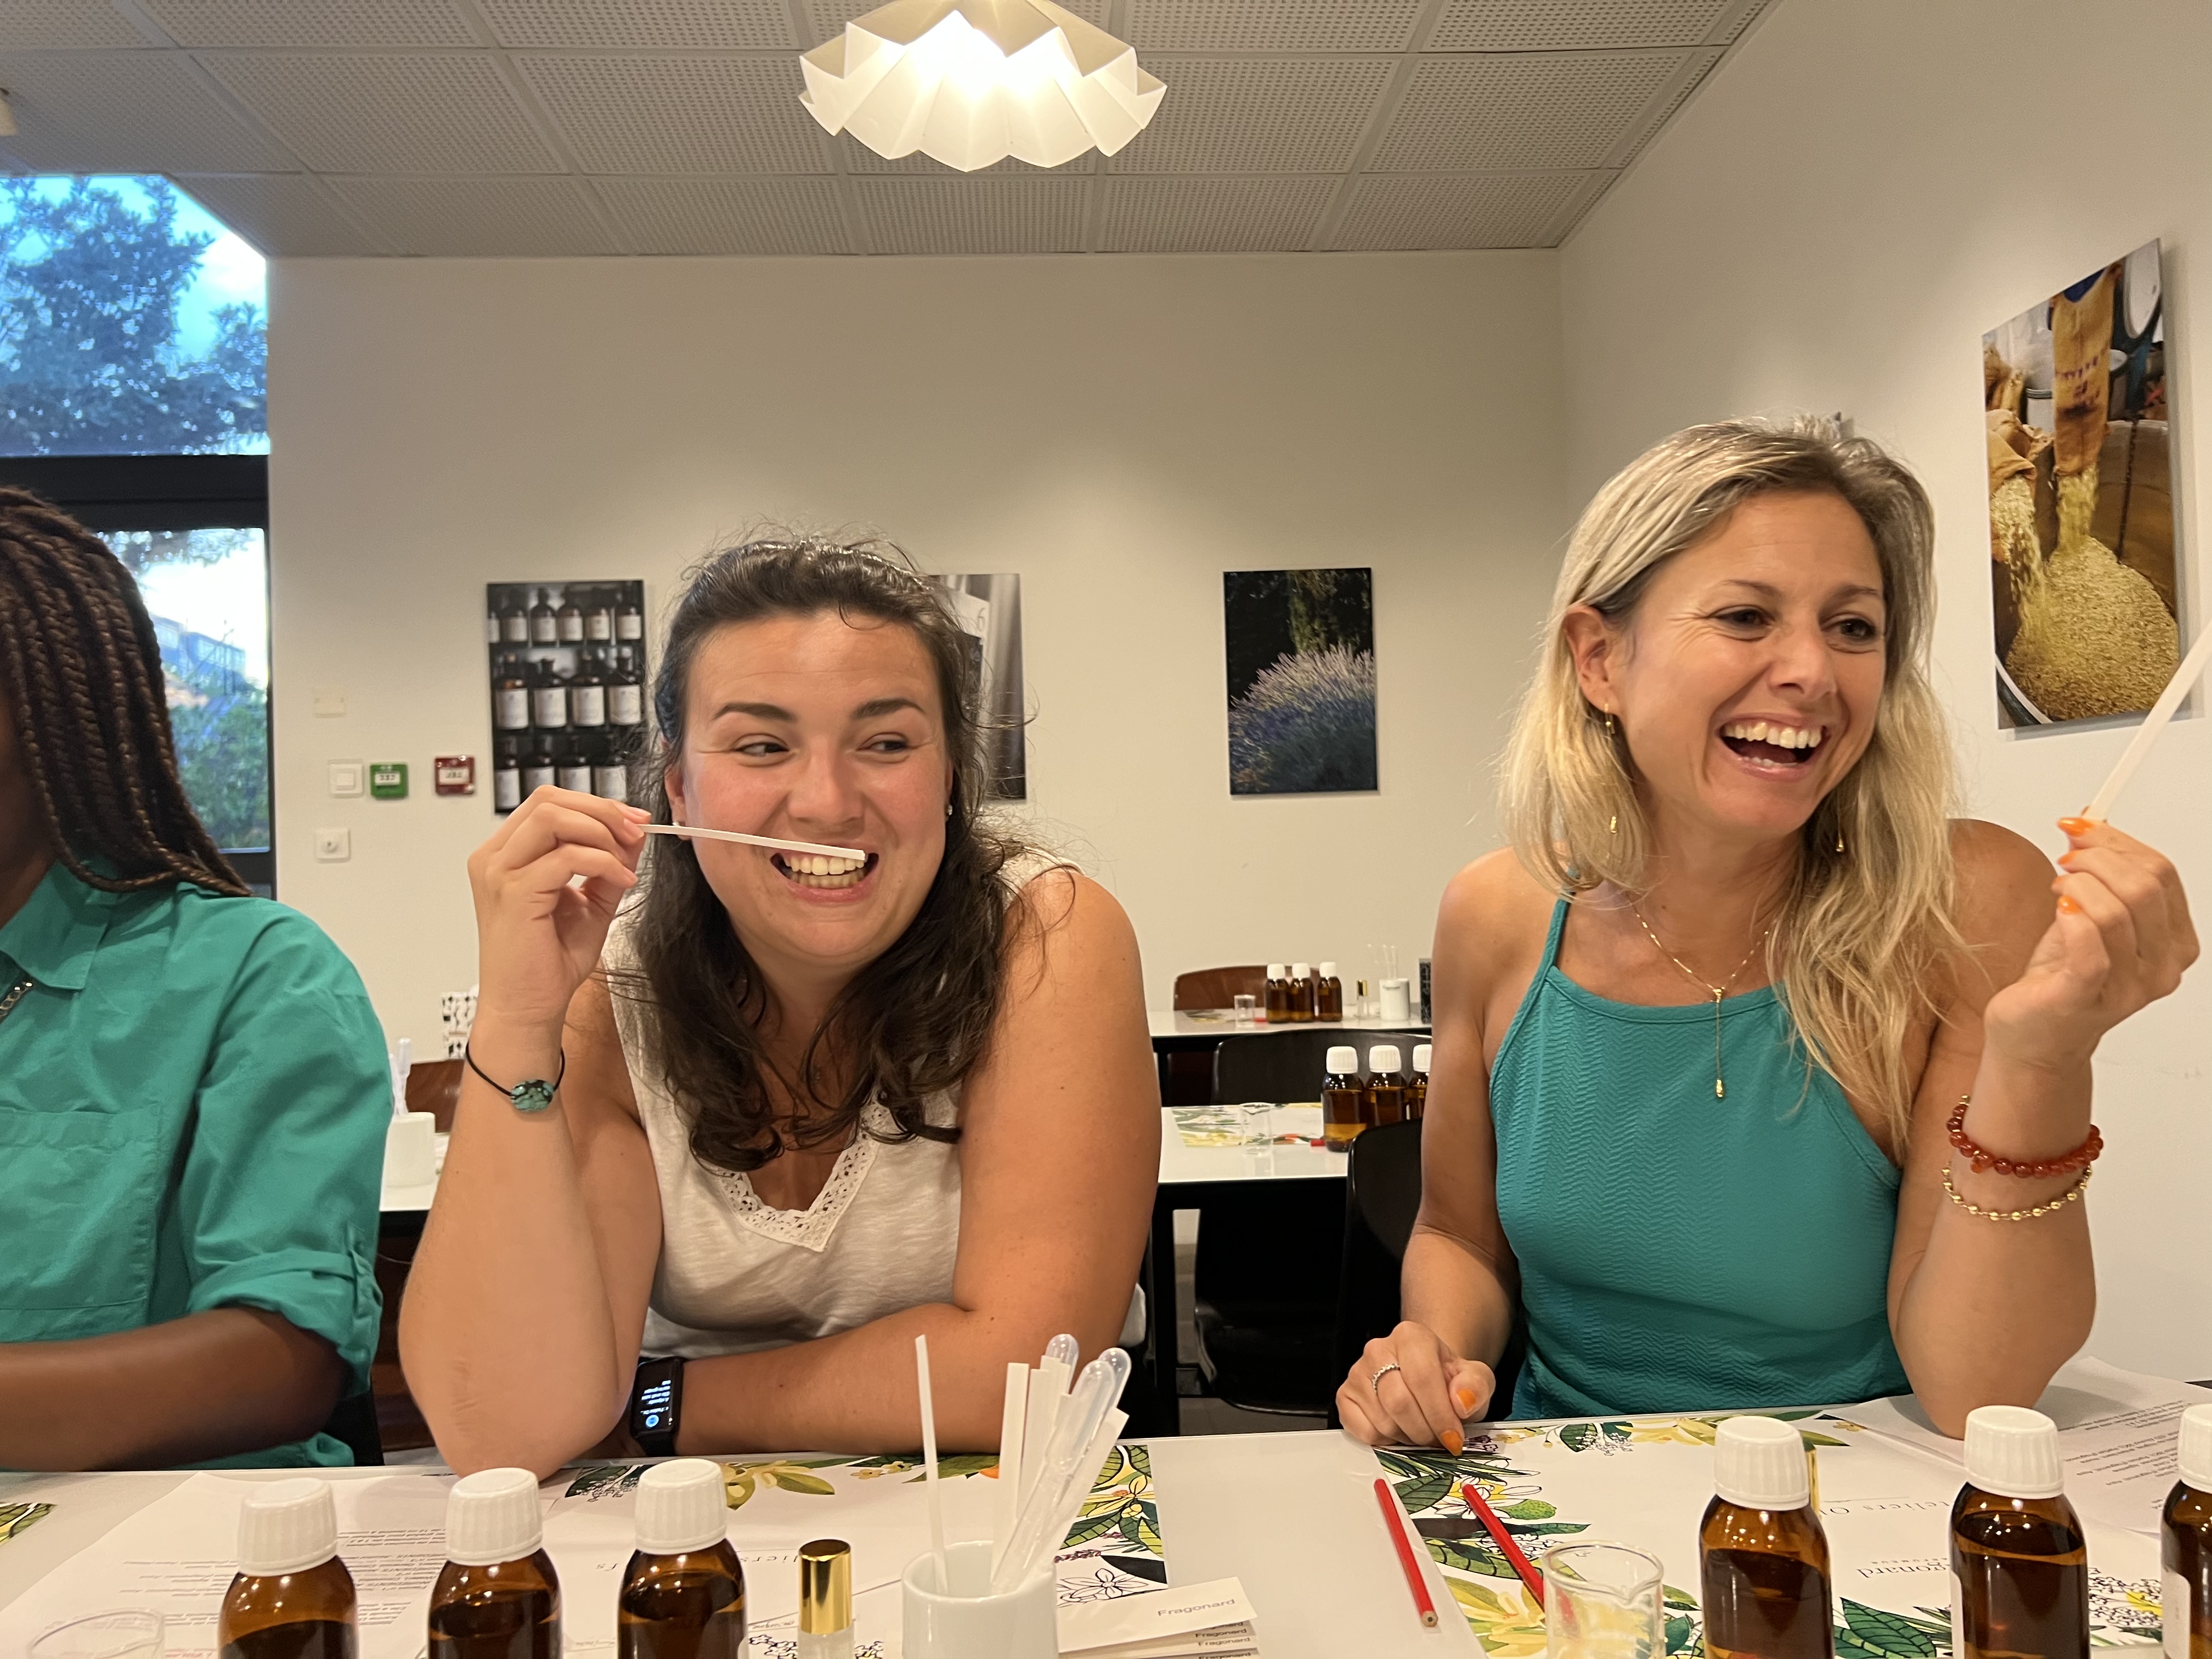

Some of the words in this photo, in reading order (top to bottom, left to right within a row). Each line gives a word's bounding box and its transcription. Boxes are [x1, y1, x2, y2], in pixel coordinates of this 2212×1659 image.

[1863, 1500, 1950, 1511] teliers
[1857, 1561, 1949, 1578] gonard
[1158, 1599, 1235, 1616] Fragonard
[1195, 1628, 1247, 1638] Fragonard
[1198, 1637, 1250, 1646] Fragonard
